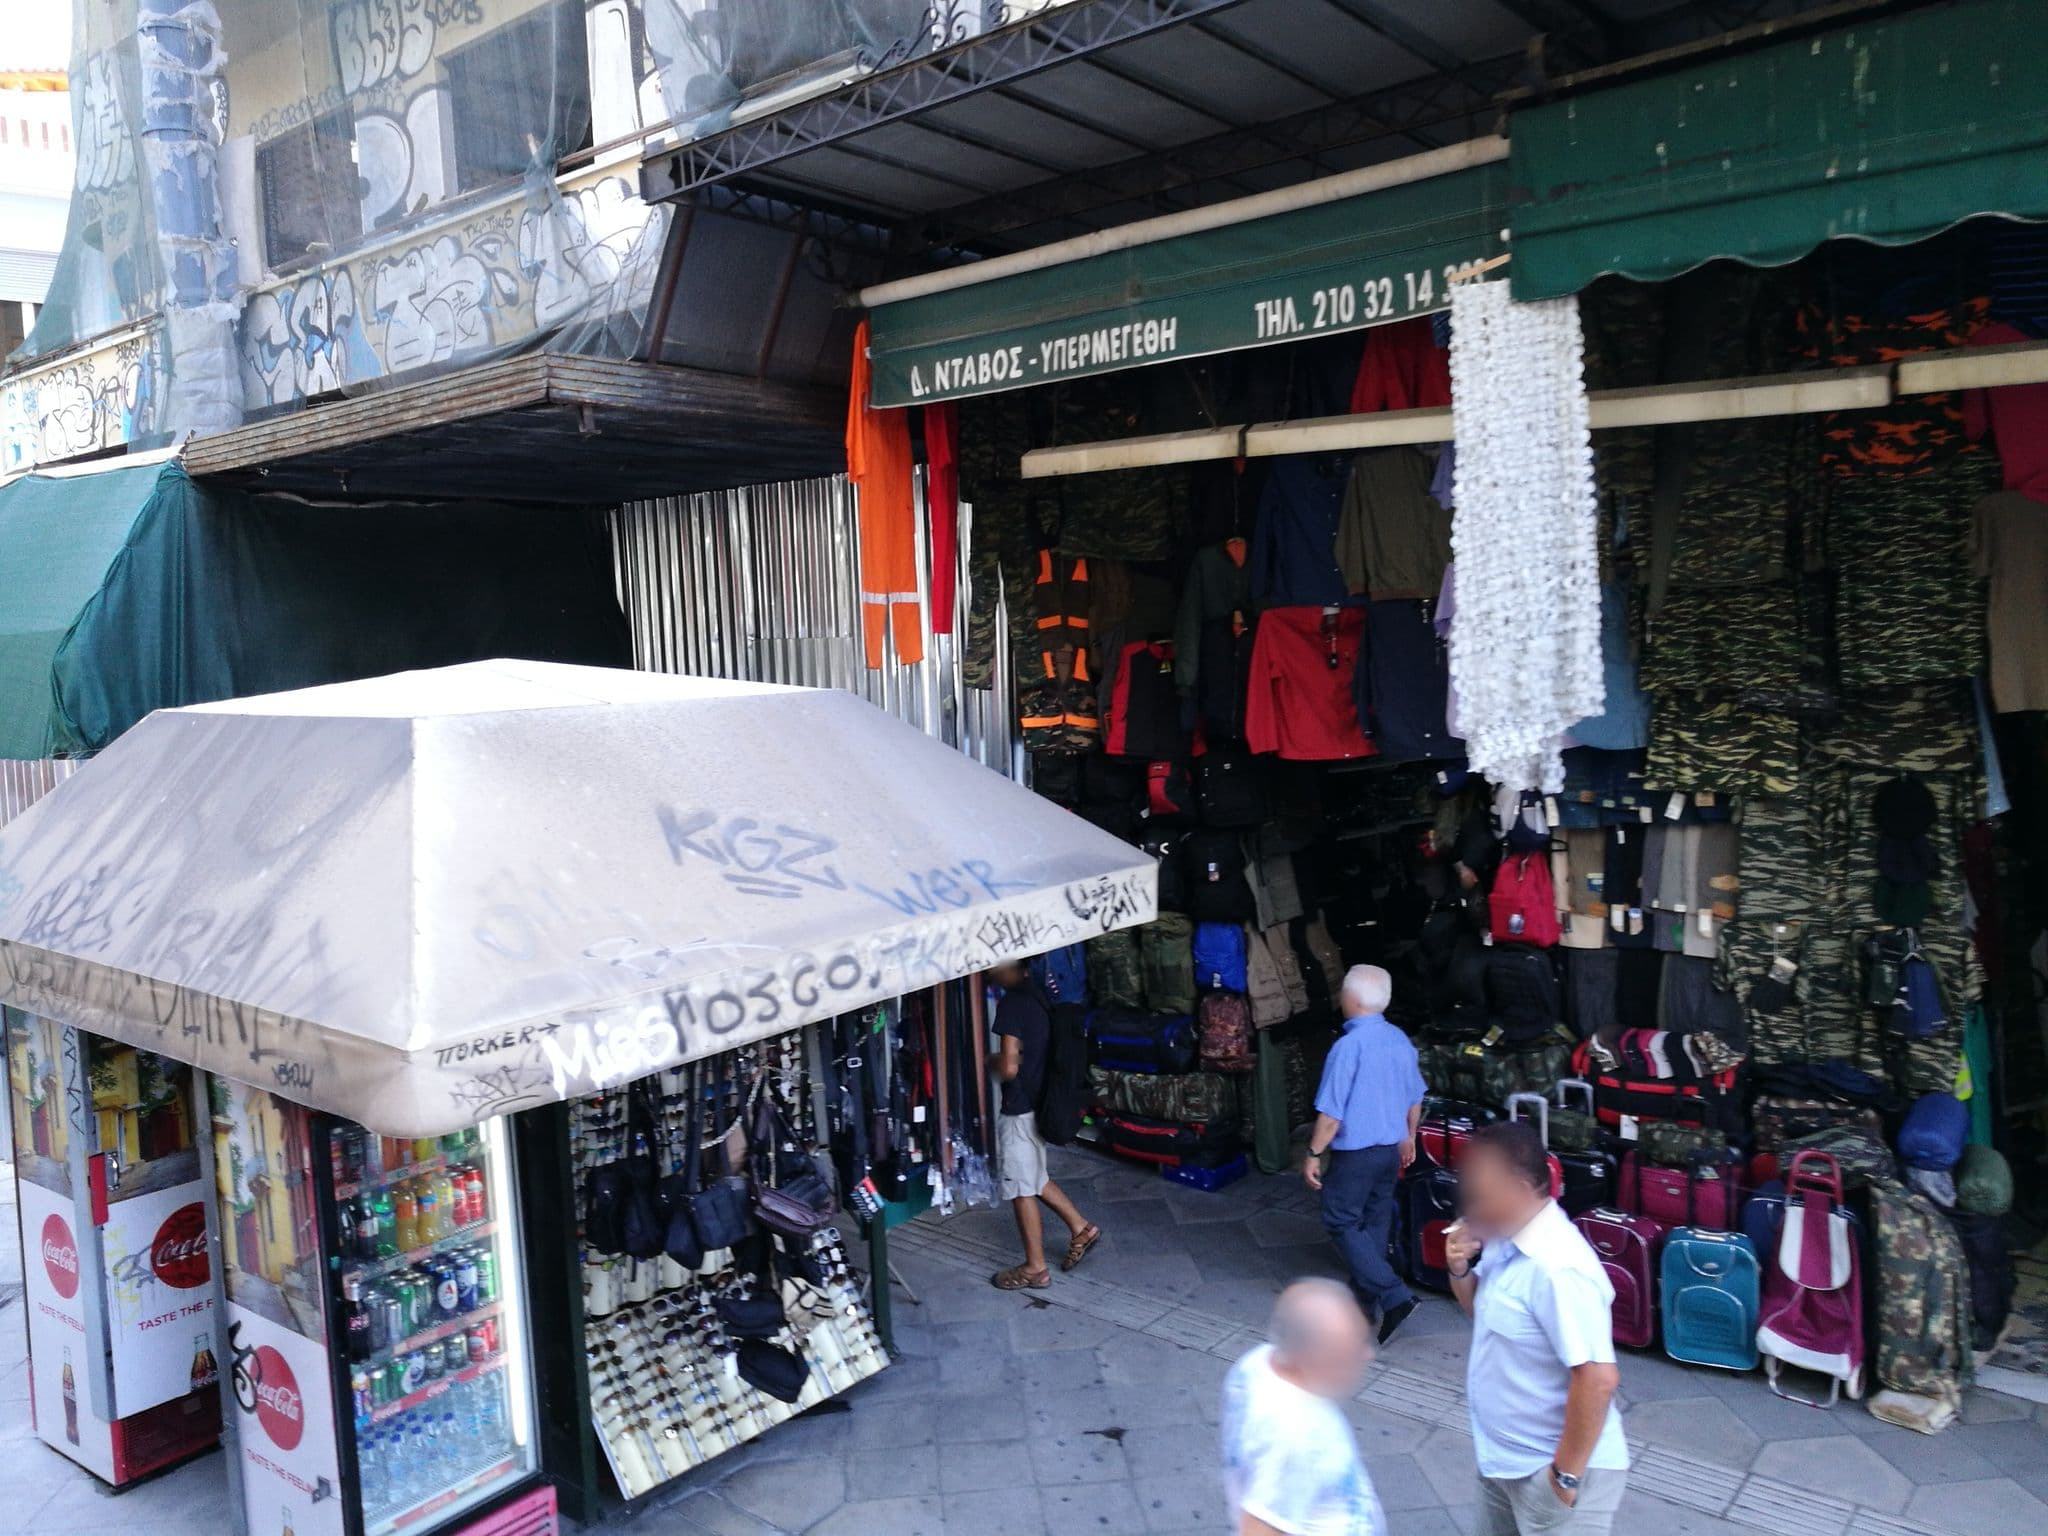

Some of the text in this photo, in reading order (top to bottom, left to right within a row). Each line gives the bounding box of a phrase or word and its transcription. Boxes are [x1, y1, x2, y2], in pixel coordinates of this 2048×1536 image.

[1254, 297, 1304, 338] ΤΗΛ.
[1312, 285, 1355, 328] 210
[1363, 277, 1394, 319] 32
[1404, 269, 1434, 311] 14
[911, 365, 930, 397] Δ.
[935, 346, 1023, 391] ΝΤΑΒΟΣ
[138, 1311, 177, 1331] TASTE
[180, 1302, 208, 1318] THE
